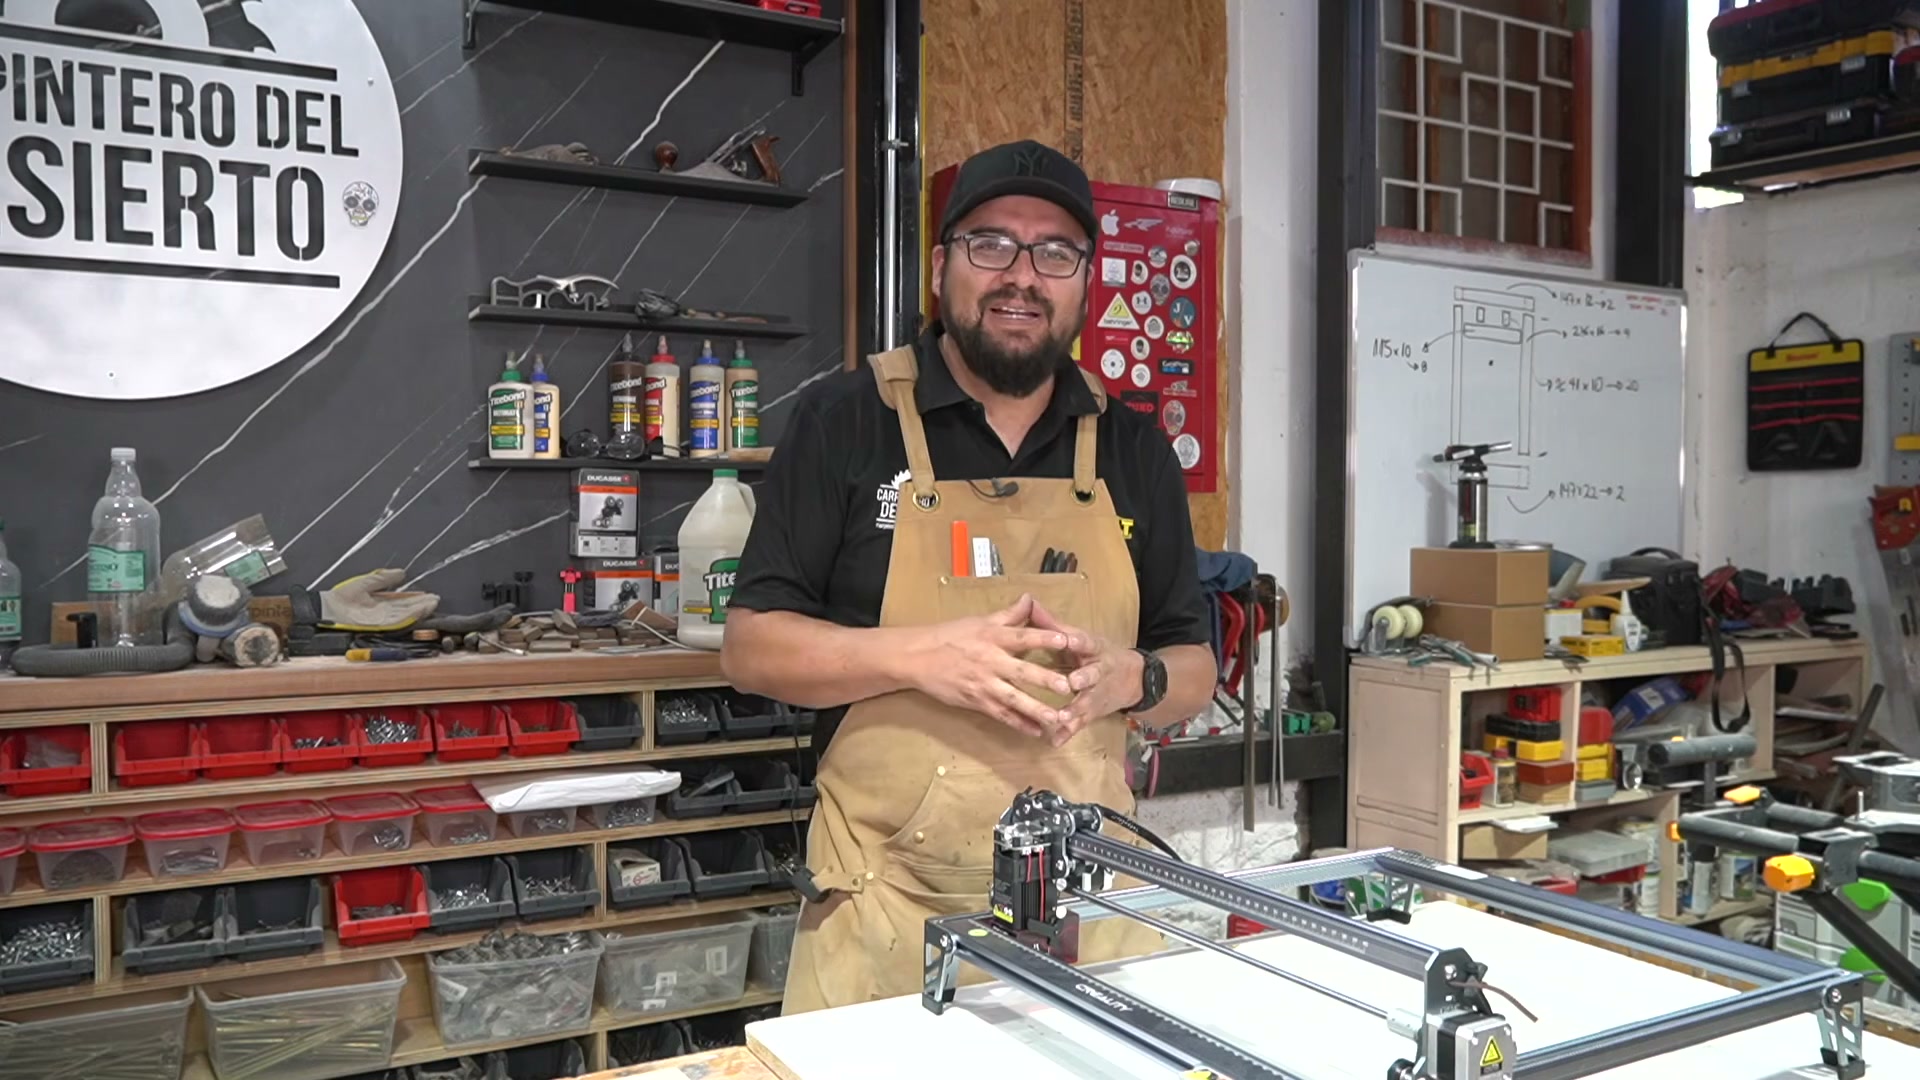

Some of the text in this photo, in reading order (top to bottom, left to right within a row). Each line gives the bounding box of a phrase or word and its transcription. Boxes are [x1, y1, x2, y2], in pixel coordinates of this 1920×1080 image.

[256, 84, 359, 157] DEL
[7, 135, 325, 262] SIERTO
[1075, 983, 1134, 1012] CREALITY
